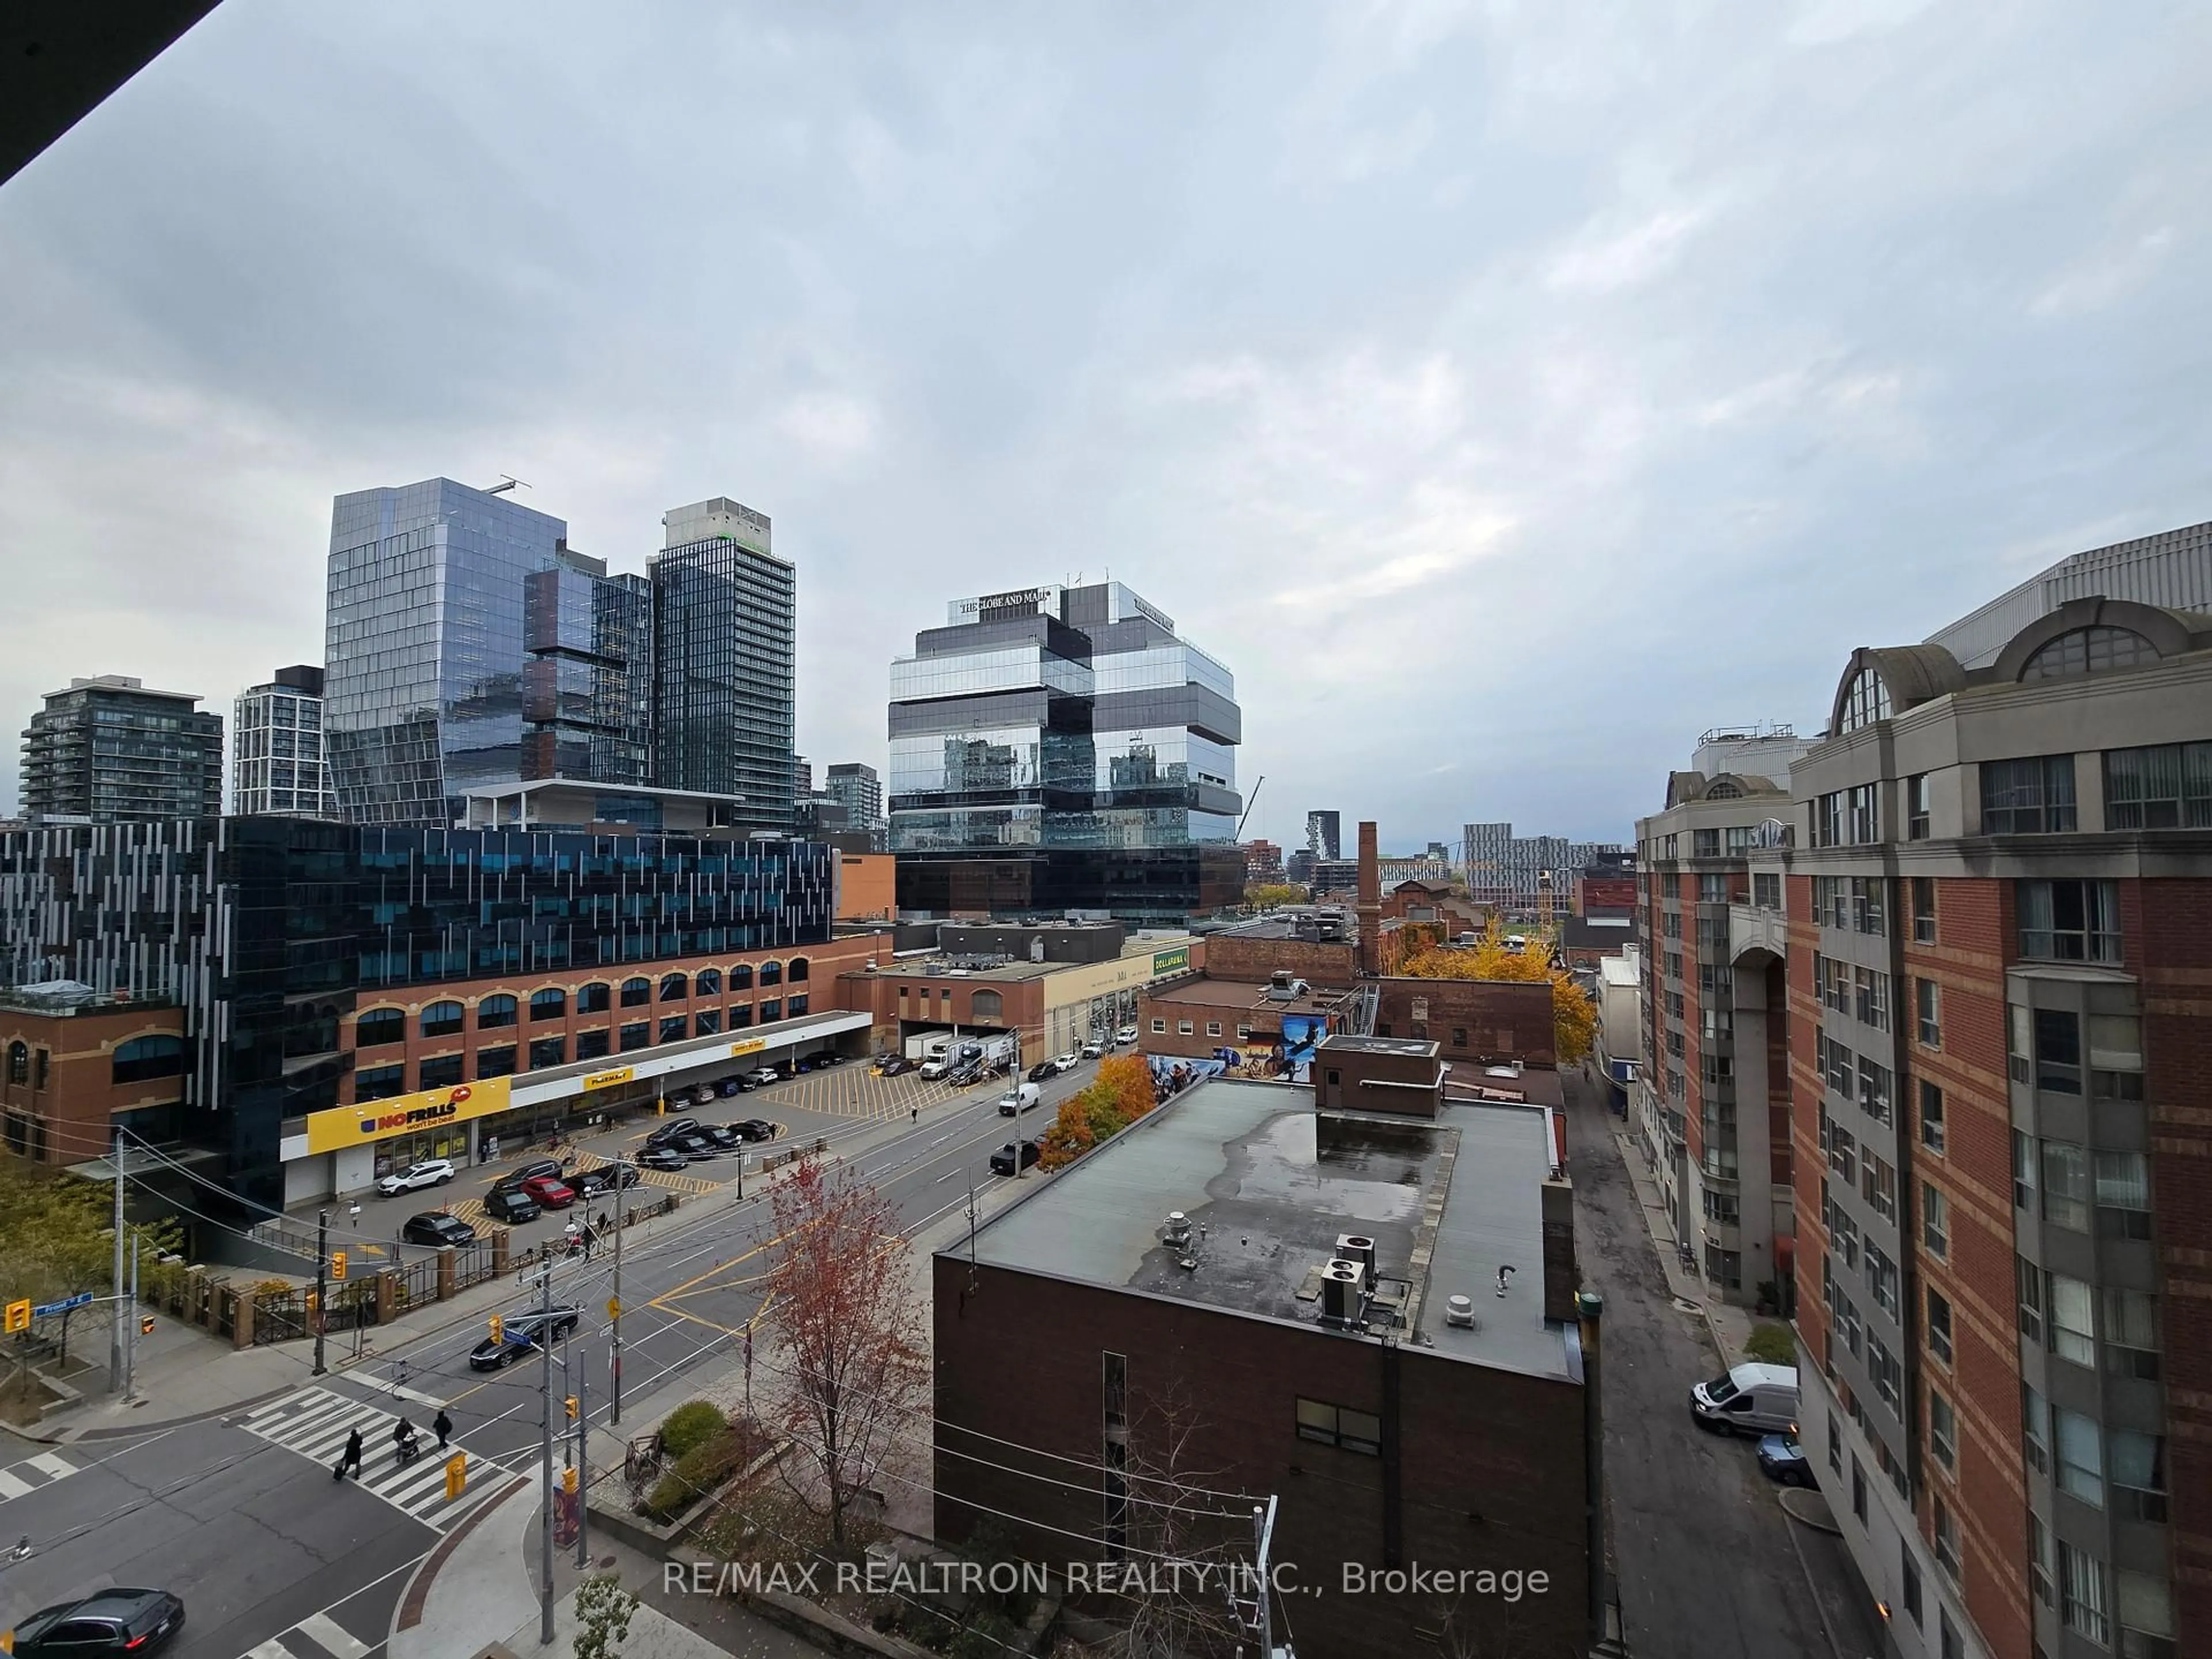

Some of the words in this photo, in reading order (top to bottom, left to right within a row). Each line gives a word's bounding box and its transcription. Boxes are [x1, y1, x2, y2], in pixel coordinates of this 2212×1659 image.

[979, 598, 1003, 611] GLOBE
[1004, 594, 1023, 607] AND
[1024, 588, 1047, 604] MAIL
